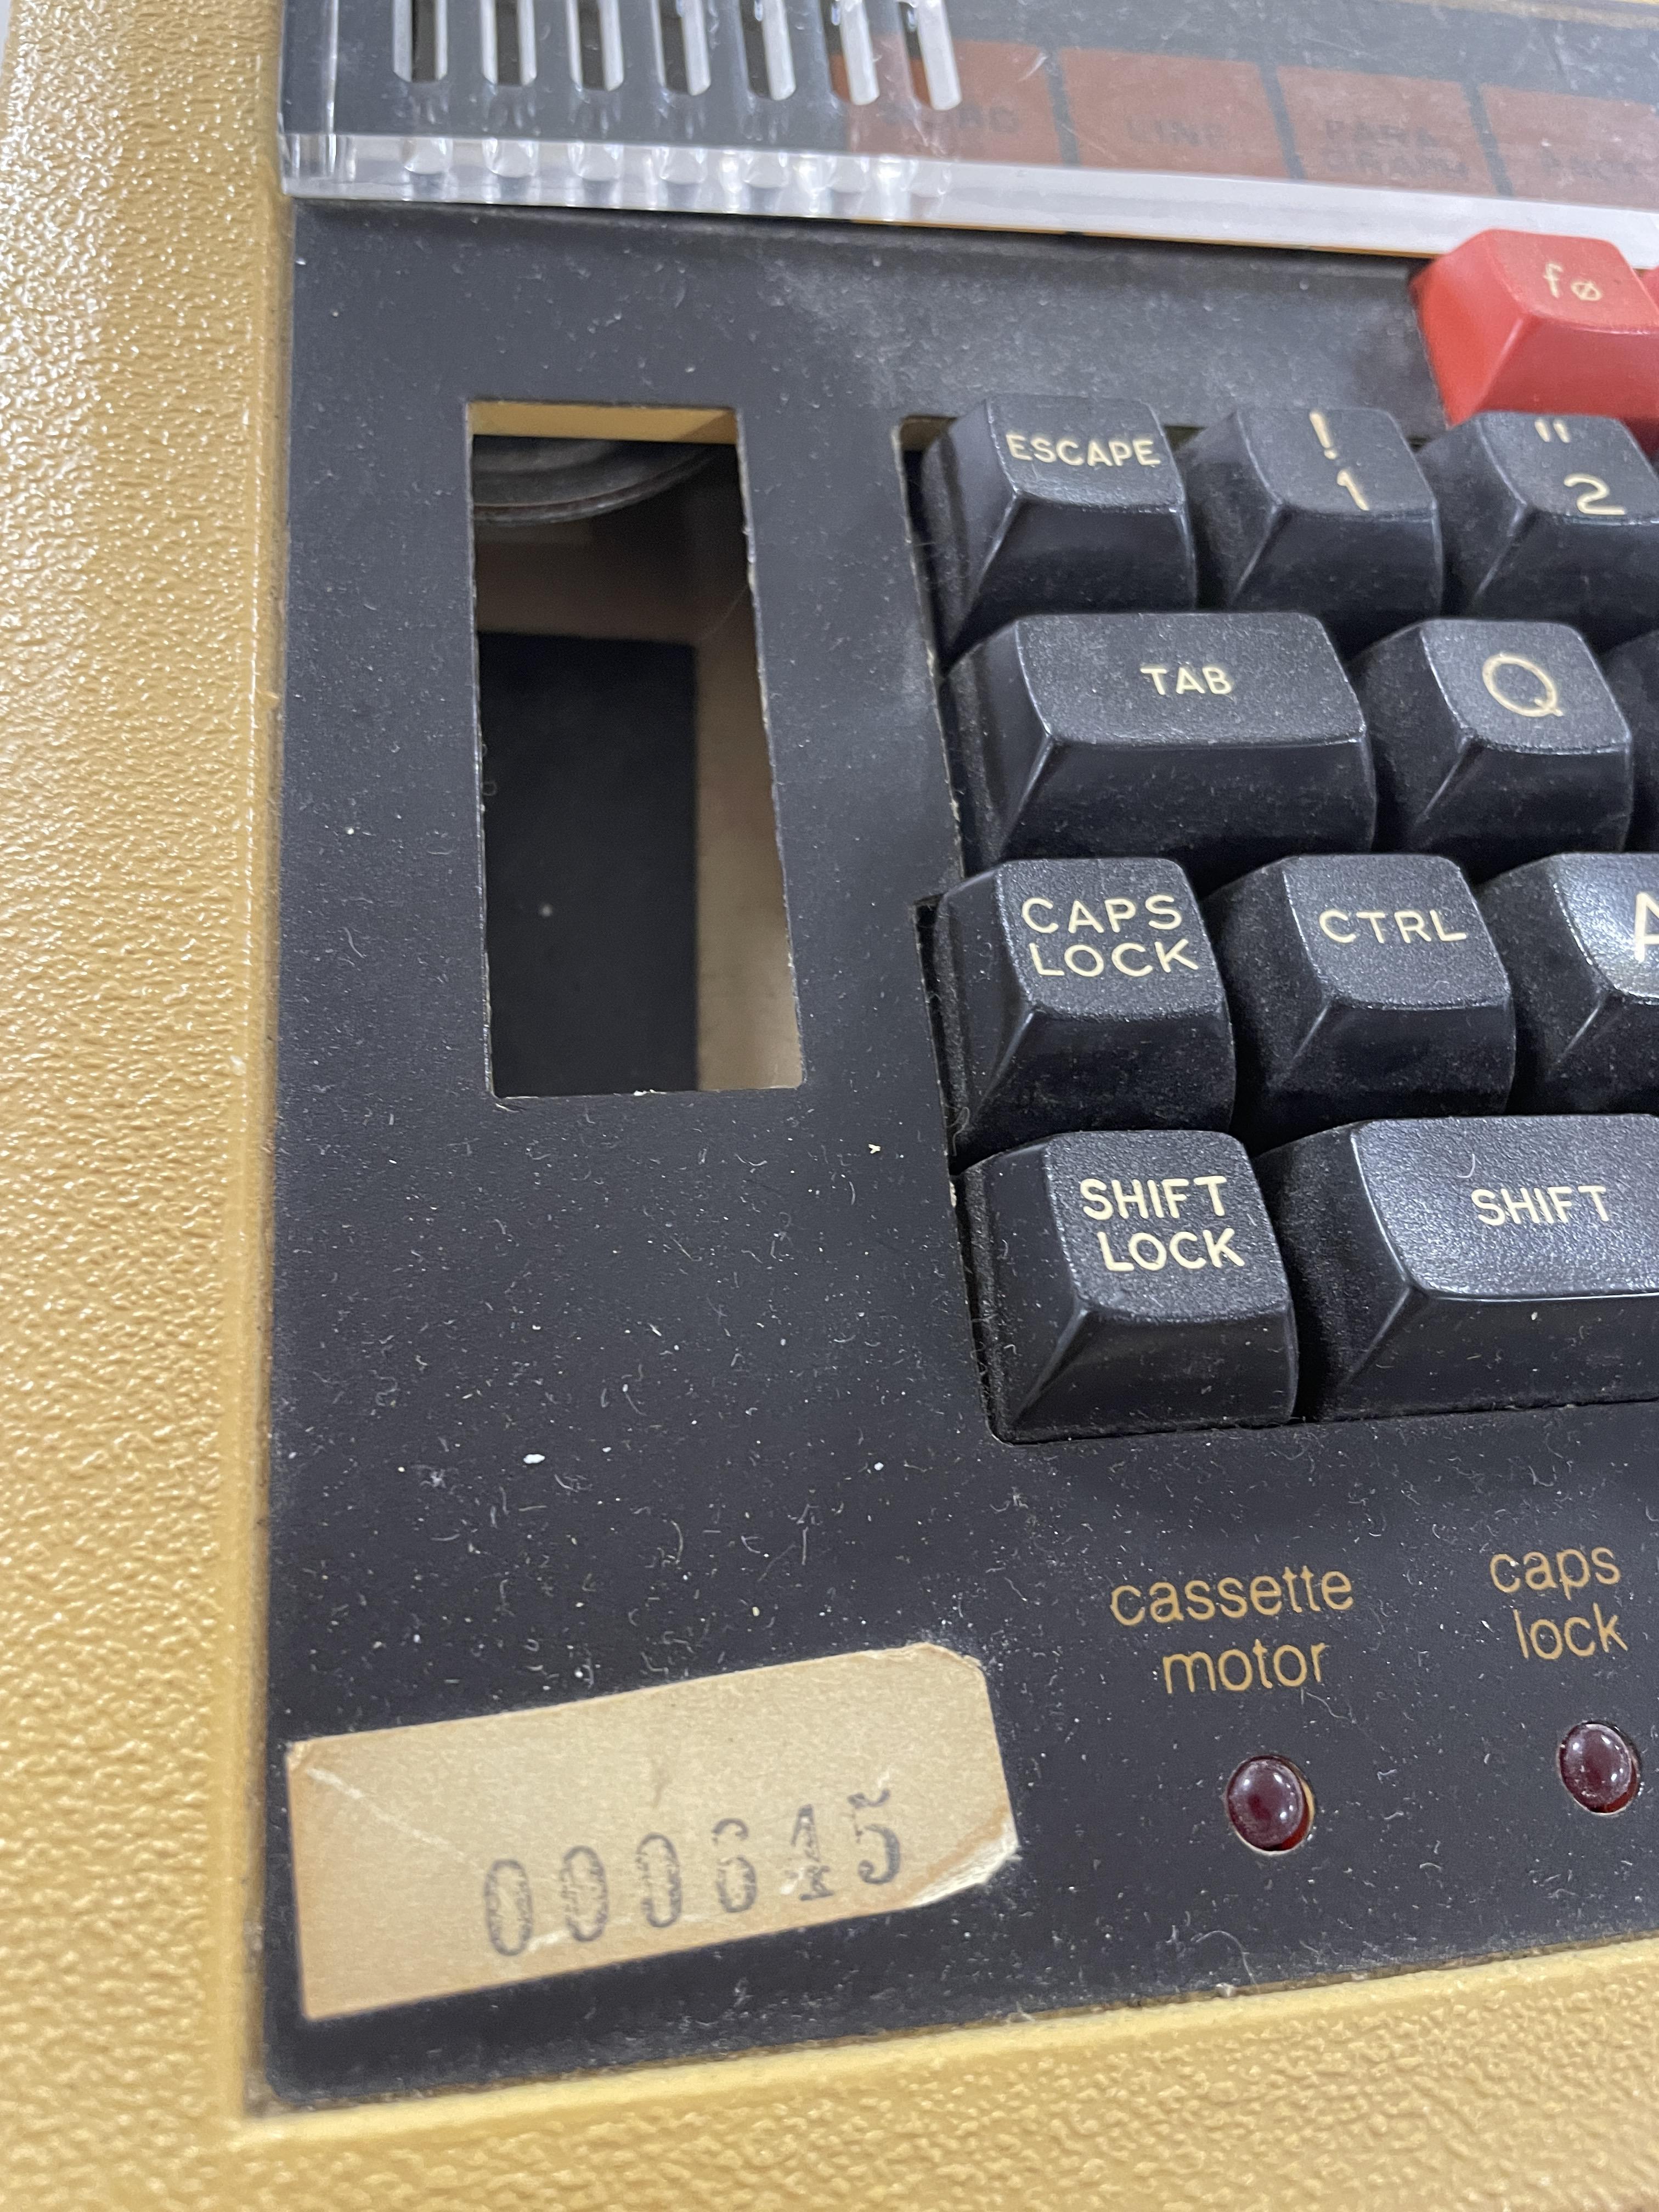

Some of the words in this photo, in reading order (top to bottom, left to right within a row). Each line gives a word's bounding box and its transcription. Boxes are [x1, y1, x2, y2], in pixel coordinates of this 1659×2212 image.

[1005, 432, 1161, 467] ESCAPE
[1336, 470, 1370, 511] 1
[1564, 474, 1626, 516] 2
[1139, 665, 1233, 696] TAB
[1482, 652, 1564, 718] Q
[1022, 894, 1183, 934] CAPS
[1318, 909, 1468, 944] CTRL
[1028, 938, 1200, 978] LOCK
[1079, 1175, 1228, 1221] SHIFT
[1470, 1184, 1610, 1226] SHIFT
[1096, 1227, 1245, 1272] LOCK
[1489, 1547, 1621, 1601] caps
[1110, 1565, 1354, 1626] cassette
[1513, 1602, 1628, 1660] lock
[1162, 1638, 1329, 1695] motor
